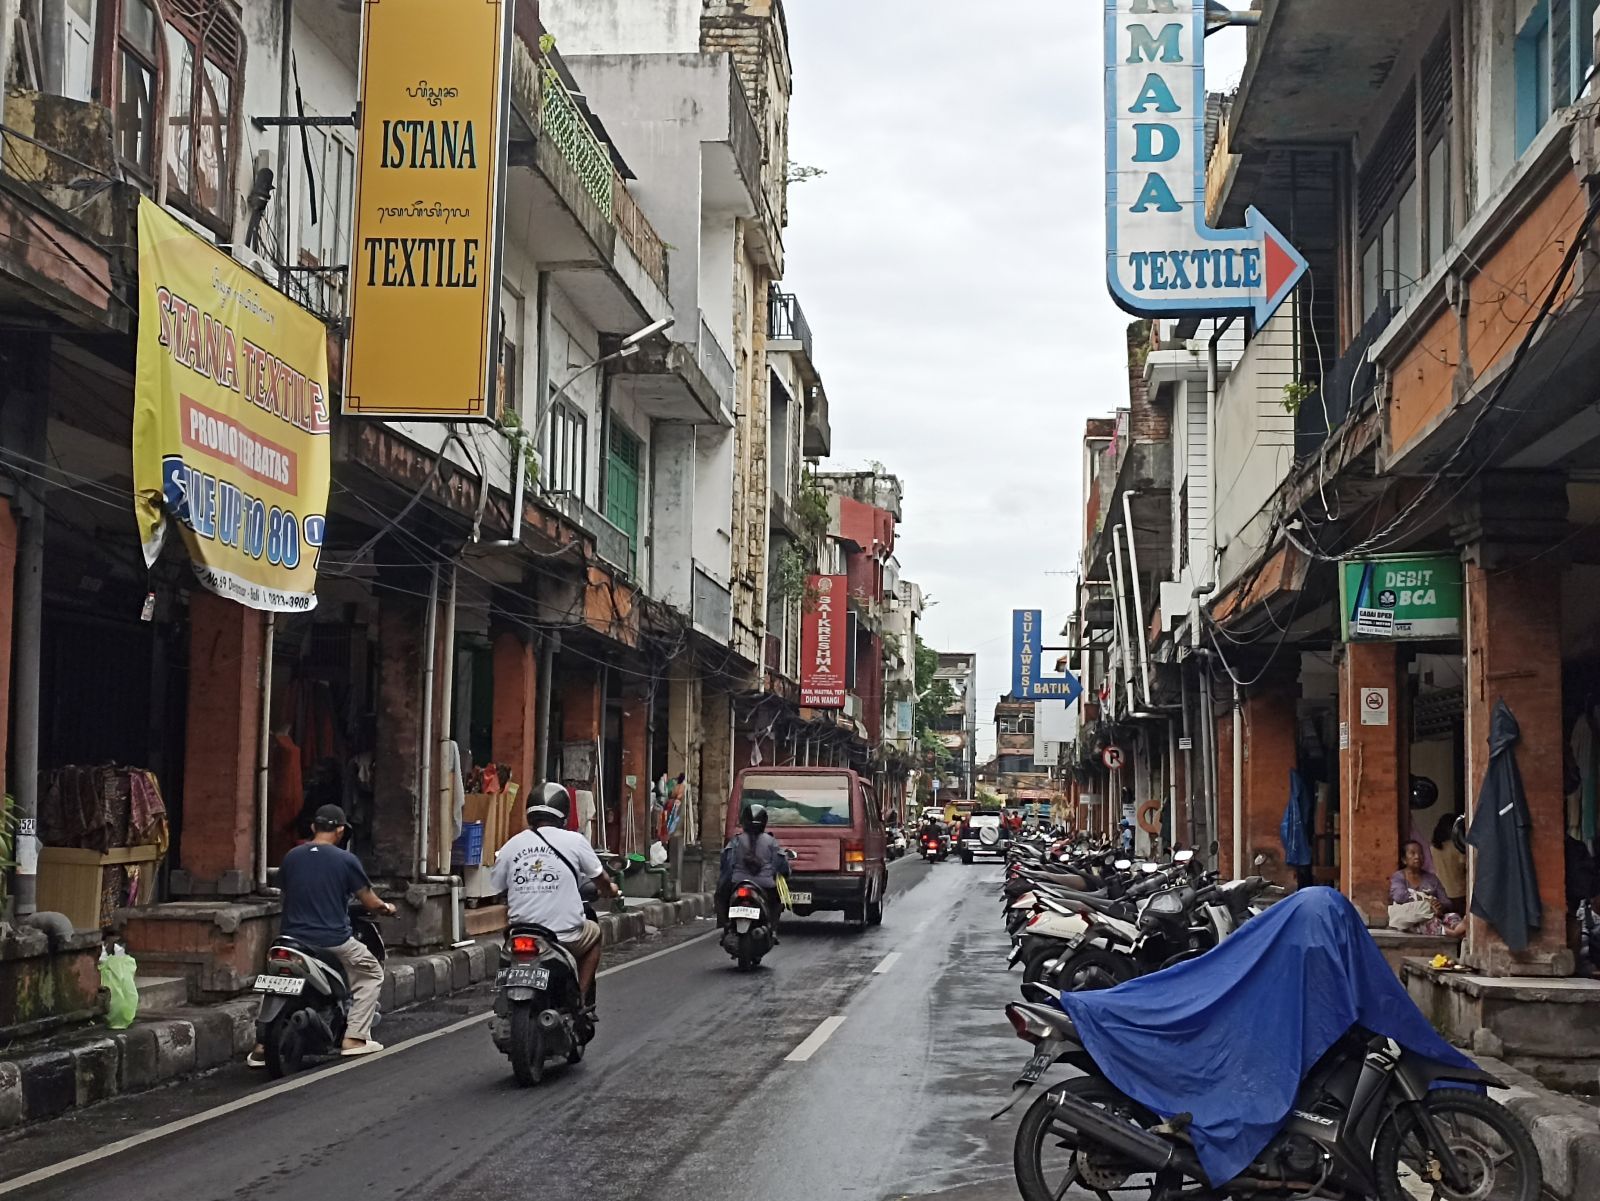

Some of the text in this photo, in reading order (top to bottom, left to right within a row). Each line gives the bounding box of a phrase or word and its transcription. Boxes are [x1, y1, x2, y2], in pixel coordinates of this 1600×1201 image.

[380, 120, 477, 169] ISTANA
[364, 237, 479, 288] TEXTILE
[1129, 248, 1262, 290] TEXTILE
[243, 337, 330, 434] TEXTILE
[190, 407, 289, 485] PROMO TERBATAS
[218, 478, 241, 549] UP
[242, 490, 266, 561] TO
[266, 505, 300, 569] 80
[1385, 570, 1433, 588] DEBIT
[1399, 589, 1437, 606] BCA
[1020, 611, 1032, 697] SULAWESI
[805, 695, 840, 704] DUPA WANGI
[1033, 683, 1071, 694] BATIK
